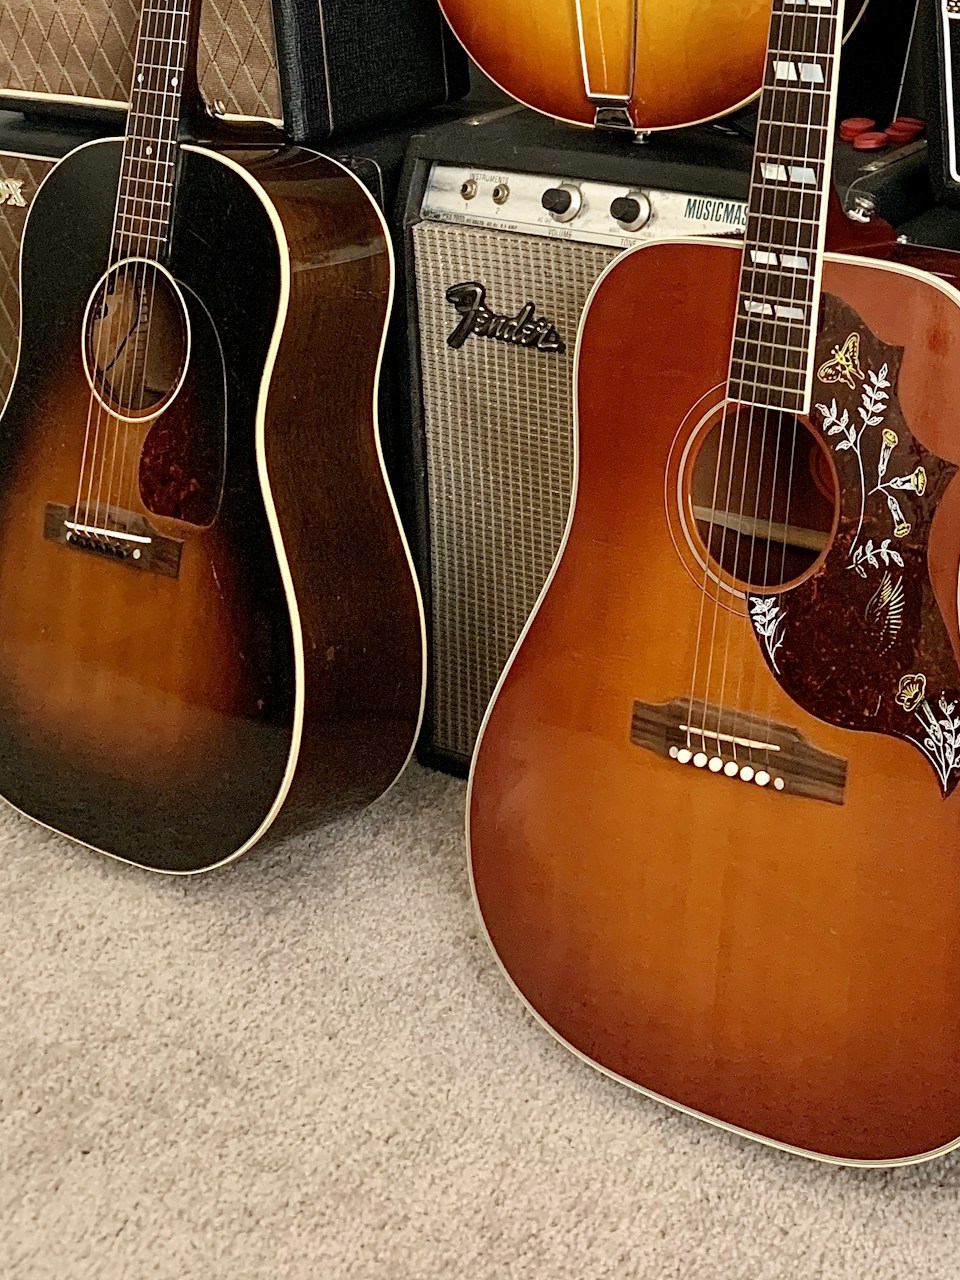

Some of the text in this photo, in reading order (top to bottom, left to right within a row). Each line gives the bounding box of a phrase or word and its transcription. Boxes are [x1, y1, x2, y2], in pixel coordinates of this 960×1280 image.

[469, 172, 510, 184] INSTRUMENTS
[548, 229, 573, 239] VOLUME
[446, 281, 566, 353] Fender
